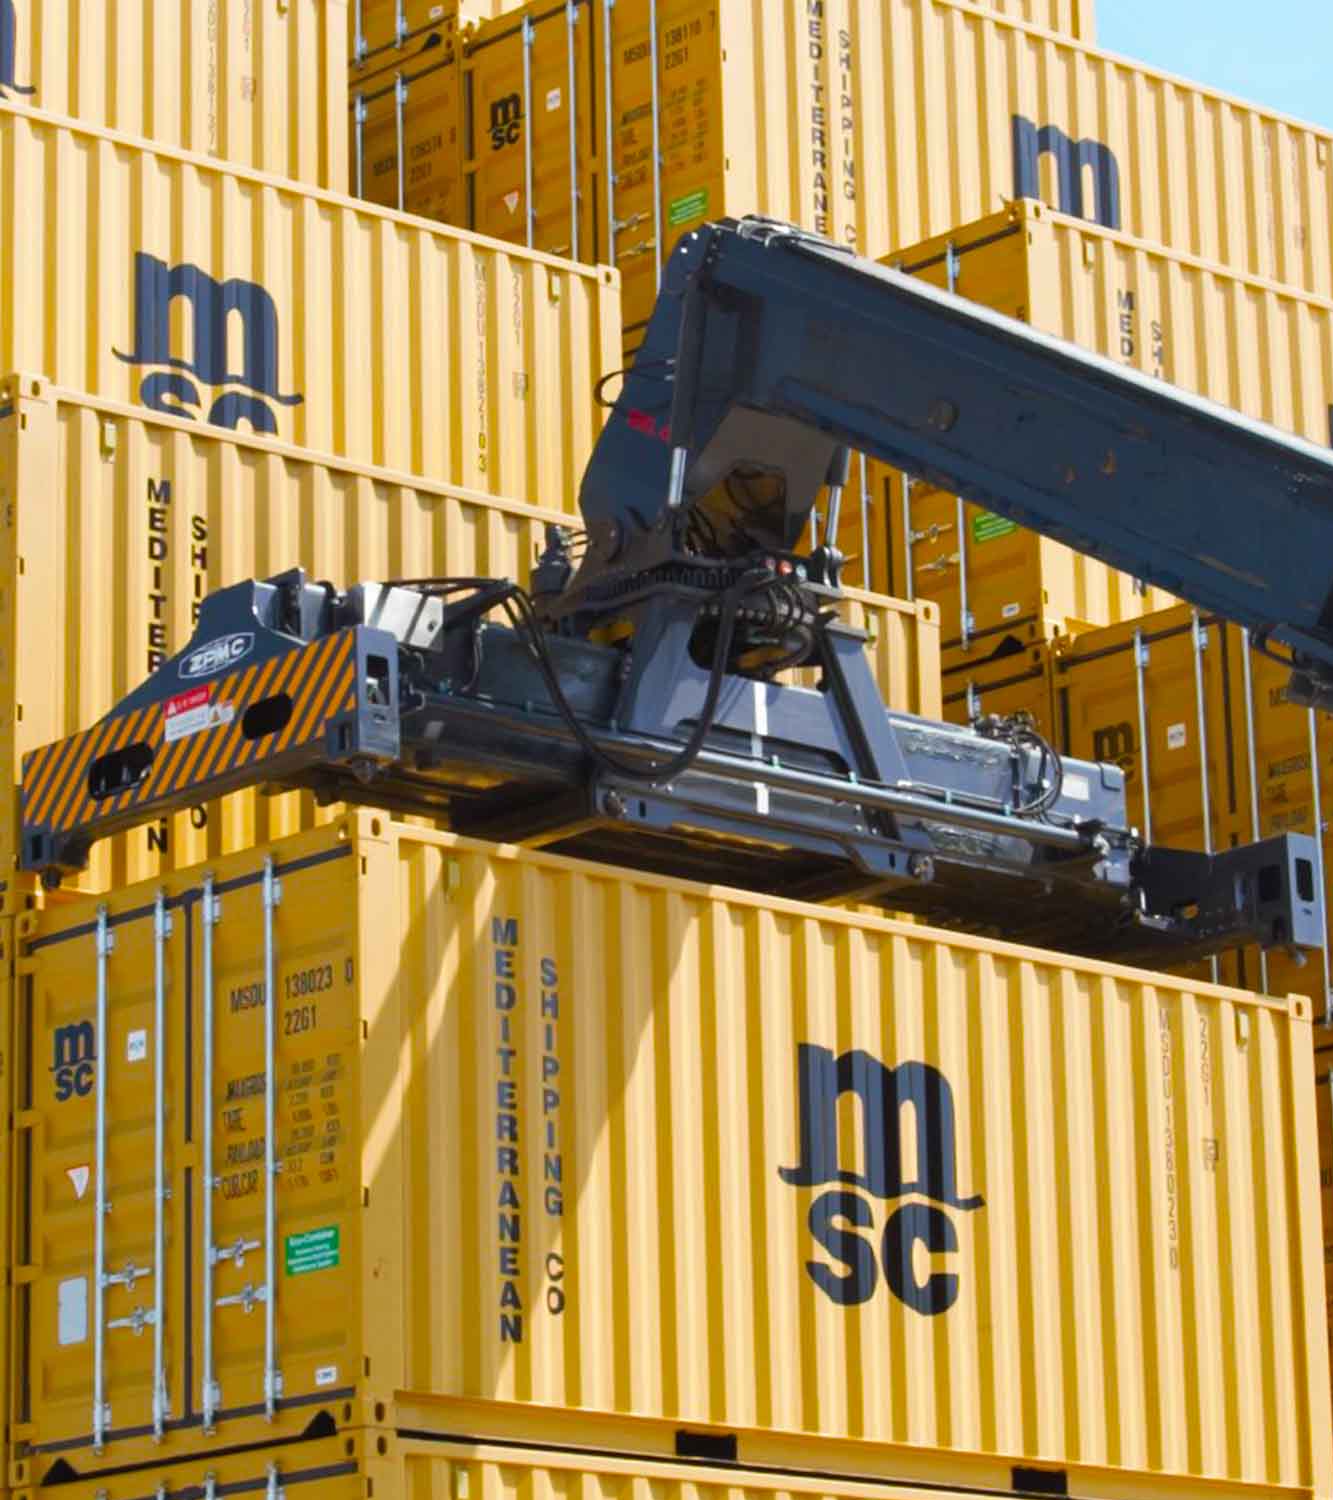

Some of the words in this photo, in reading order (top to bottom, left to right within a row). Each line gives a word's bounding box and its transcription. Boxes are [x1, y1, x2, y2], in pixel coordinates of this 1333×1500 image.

[284, 964, 334, 1001] 138023
[540, 956, 563, 1215] SHIPPING
[493, 916, 524, 1343] MEDITERRANEAN
